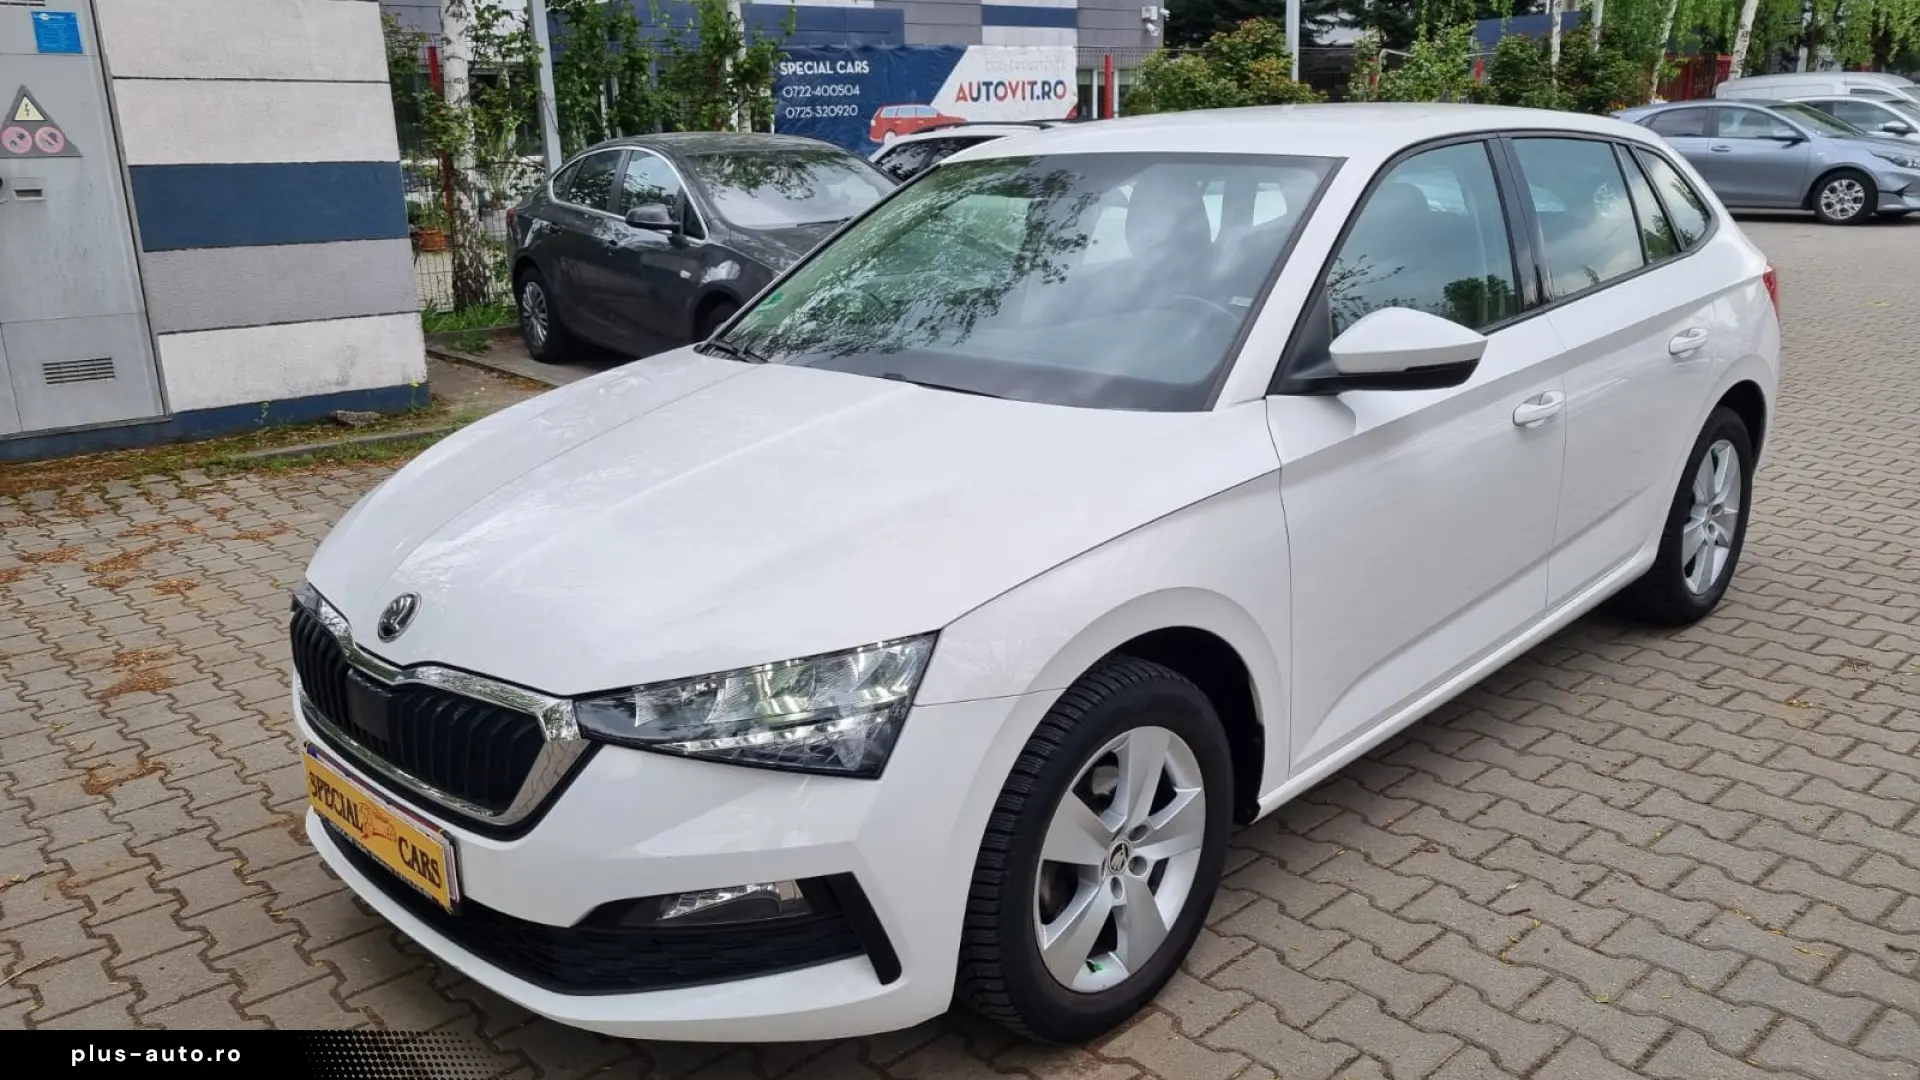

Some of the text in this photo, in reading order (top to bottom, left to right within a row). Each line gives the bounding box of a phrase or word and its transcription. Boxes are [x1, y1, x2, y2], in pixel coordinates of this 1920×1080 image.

[780, 60, 870, 75] SPECIAL CARS
[782, 84, 860, 98] 0722-400504
[955, 79, 1067, 103] AUTOVIT.RO
[309, 770, 364, 832] SPECIAL
[398, 835, 442, 889] CARS
